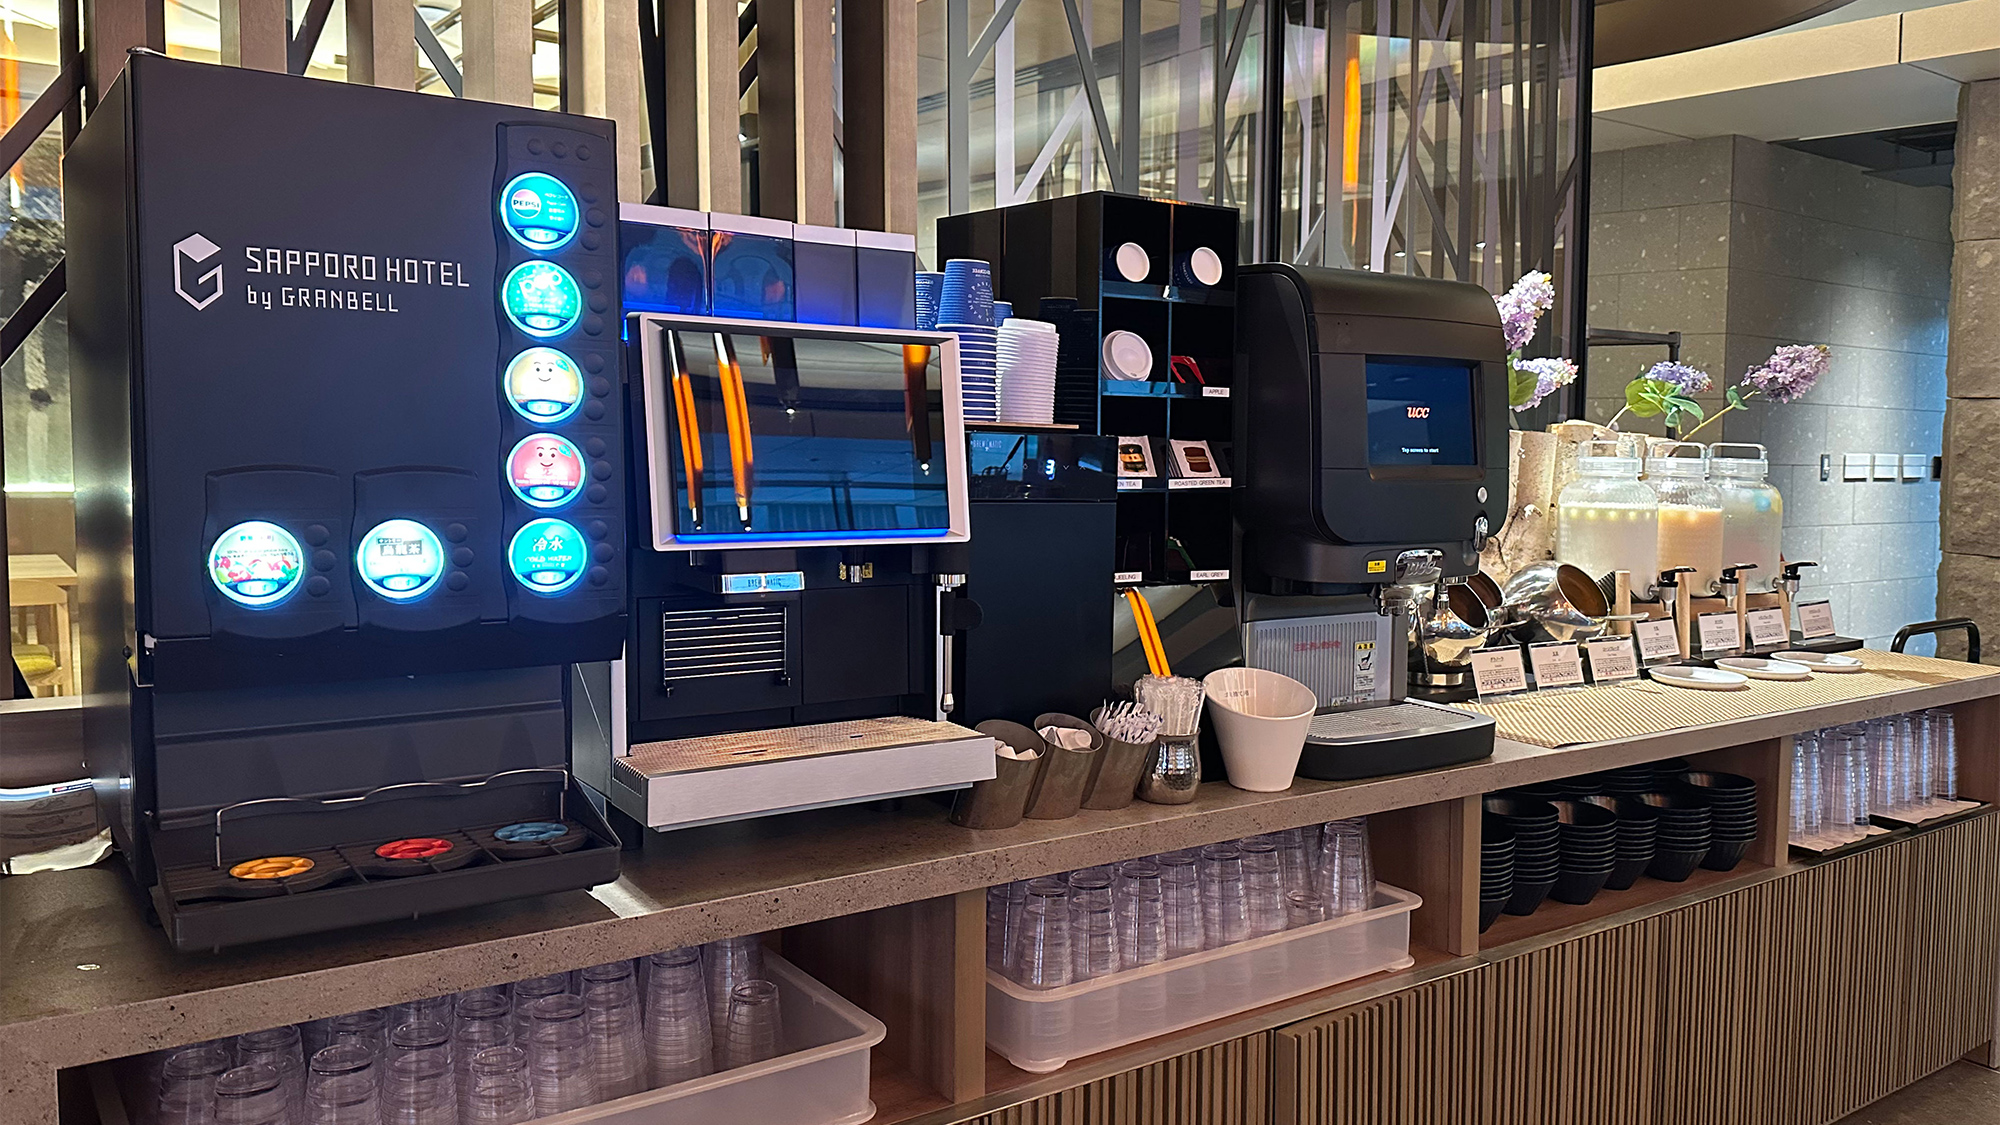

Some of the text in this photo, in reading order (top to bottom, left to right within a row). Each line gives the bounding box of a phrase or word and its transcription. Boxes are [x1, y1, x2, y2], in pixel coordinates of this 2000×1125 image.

[513, 199, 540, 208] PEPSI
[245, 246, 470, 288] SAPPORO HOTEL
[247, 284, 399, 312] by GRANBELL
[1406, 406, 1431, 419] ucc
[532, 536, 563, 552] 冷水
